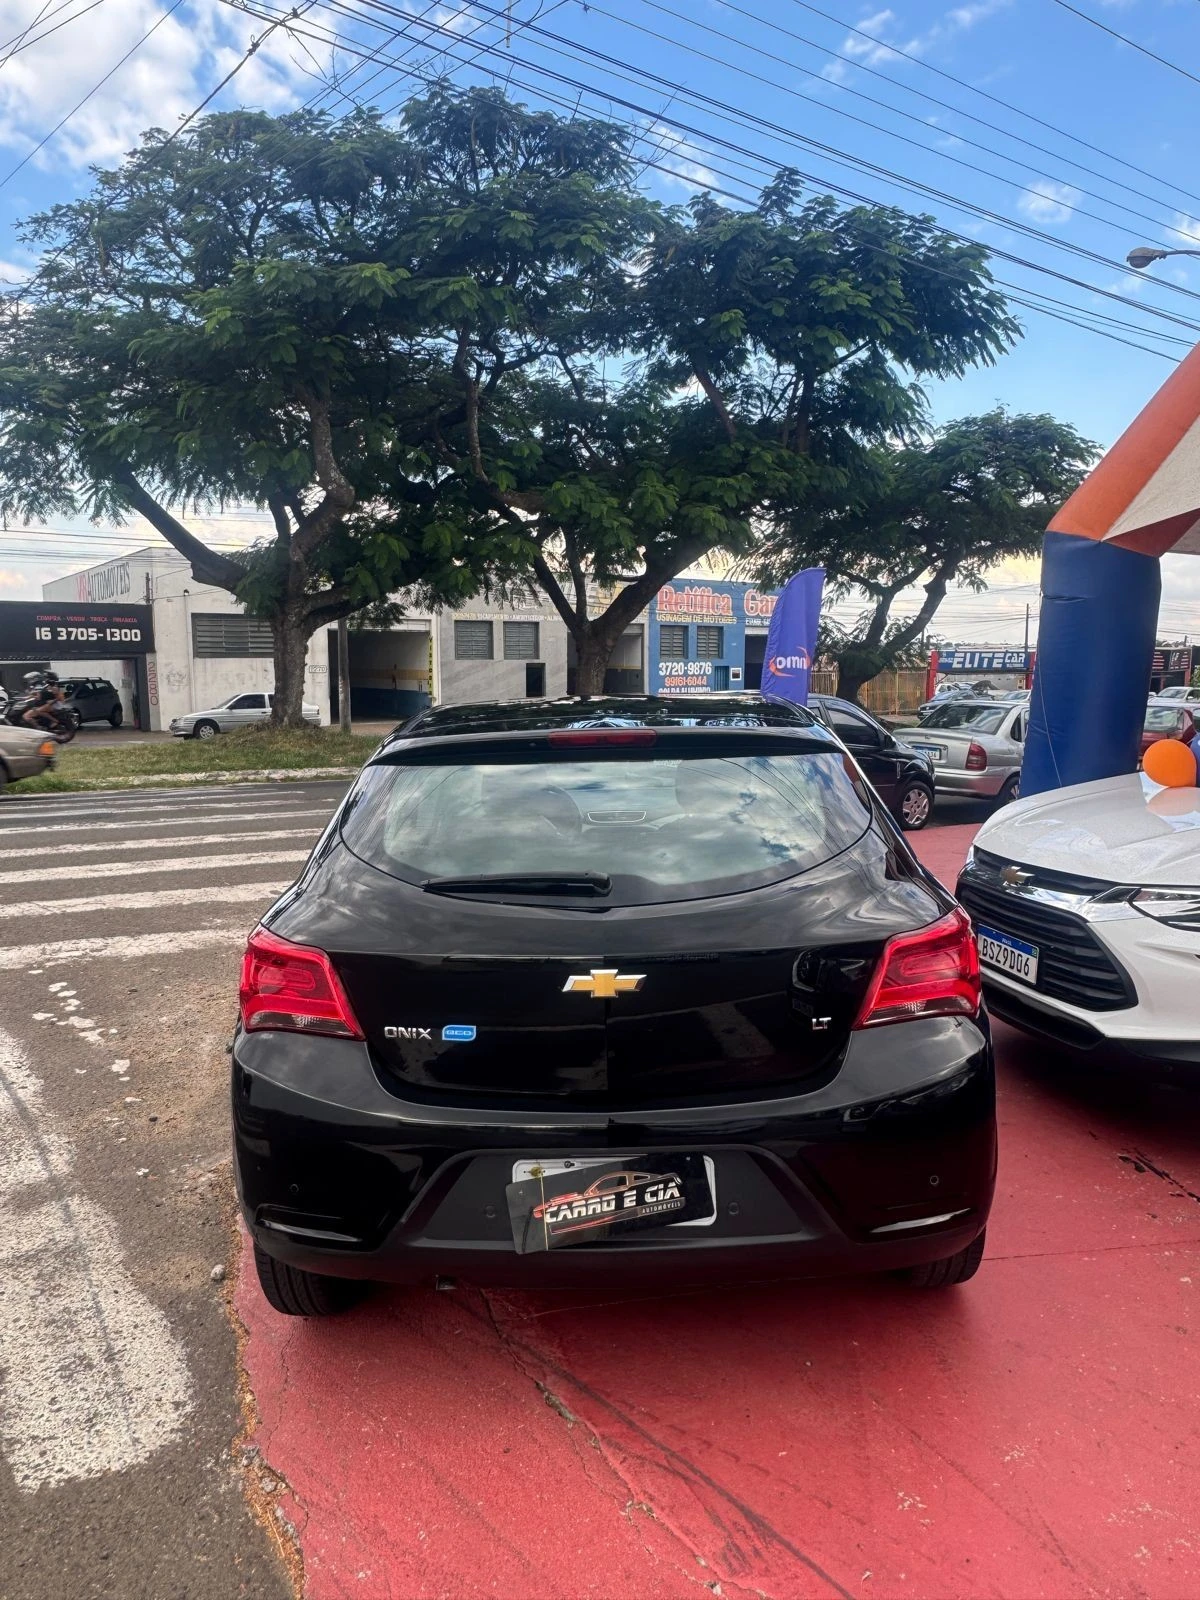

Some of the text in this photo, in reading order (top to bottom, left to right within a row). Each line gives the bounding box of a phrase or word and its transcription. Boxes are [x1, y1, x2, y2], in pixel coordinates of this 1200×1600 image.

[35, 627, 141, 642] 16 3705-1300
[952, 652, 1005, 669] ELITE
[1005, 652, 1026, 663] CAR
[981, 937, 1030, 977] BSZ9D06
[811, 1016, 832, 1030] LT
[384, 1026, 432, 1040] ONIX
